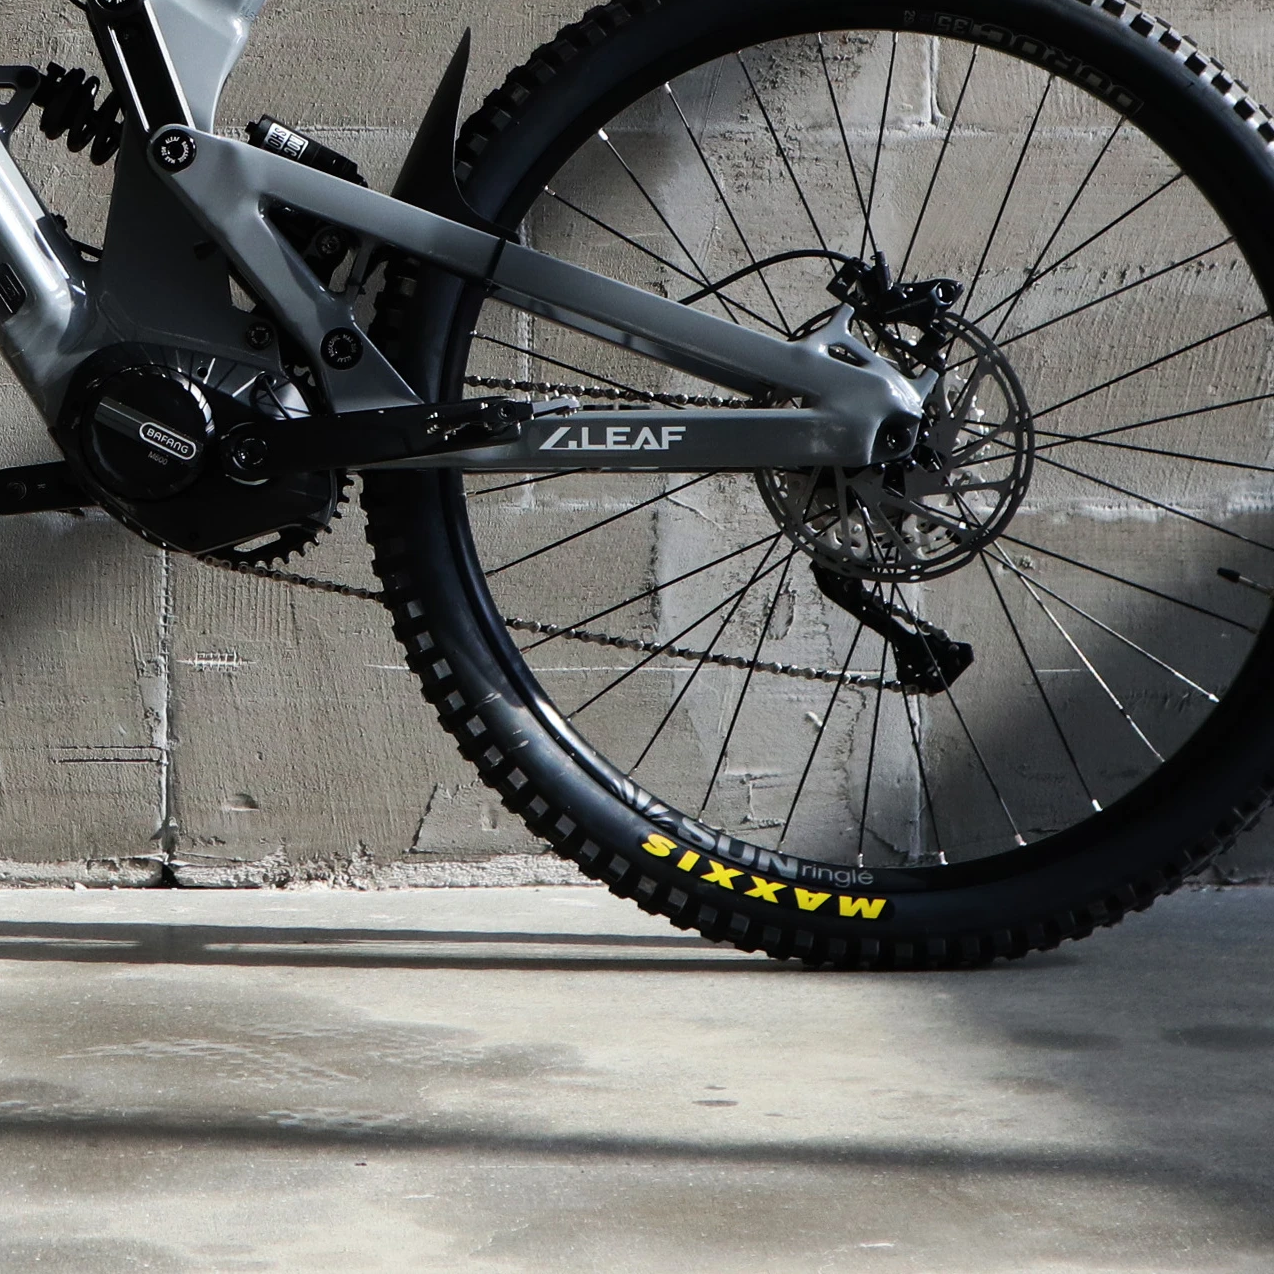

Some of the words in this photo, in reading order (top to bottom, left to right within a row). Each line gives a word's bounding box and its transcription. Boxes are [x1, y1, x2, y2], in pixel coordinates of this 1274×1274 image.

[266, 127, 287, 150] SHO
[283, 134, 305, 157] ROC
[146, 428, 189, 454] BAFANG
[677, 816, 799, 880] SUN
[641, 833, 887, 920] MAXXIS
